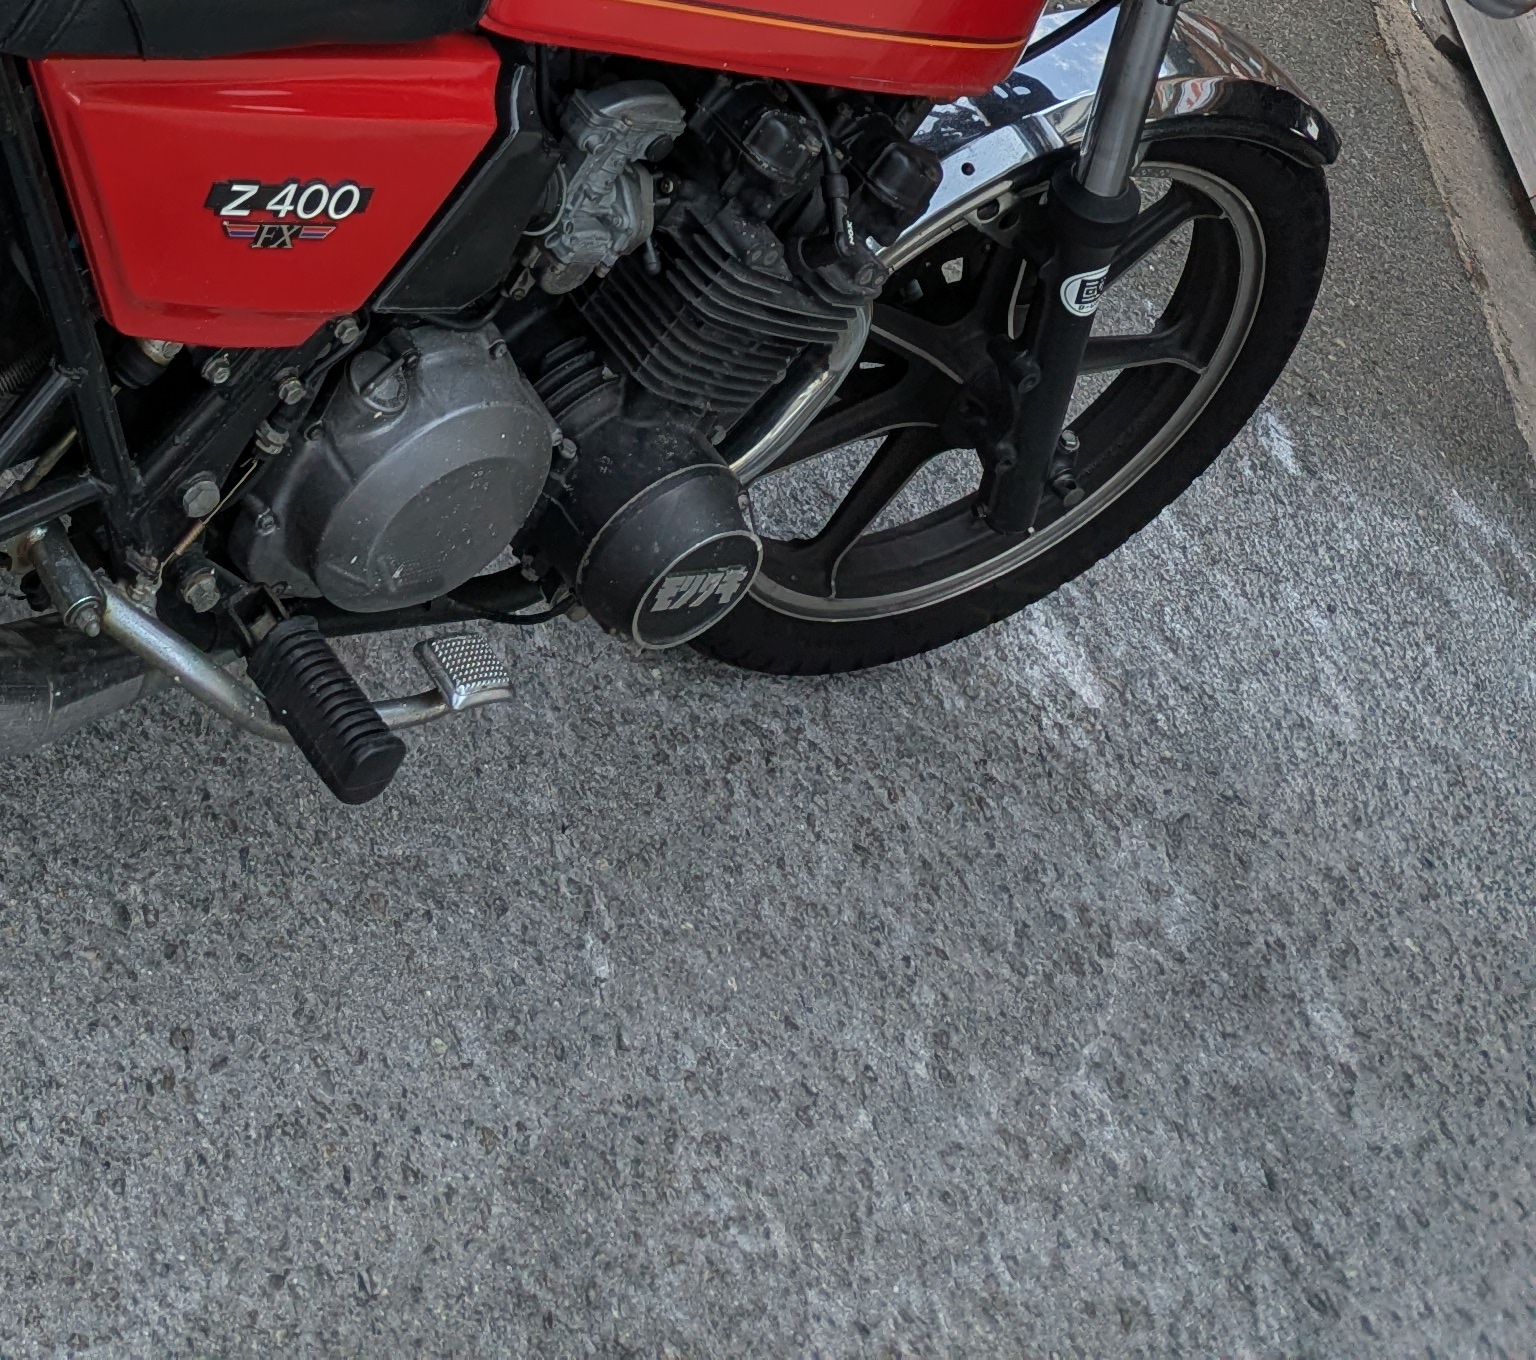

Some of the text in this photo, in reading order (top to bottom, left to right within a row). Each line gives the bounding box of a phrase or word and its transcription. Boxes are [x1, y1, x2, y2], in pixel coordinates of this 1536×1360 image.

[219, 183, 361, 220] Z 400
[251, 224, 302, 249] FX
